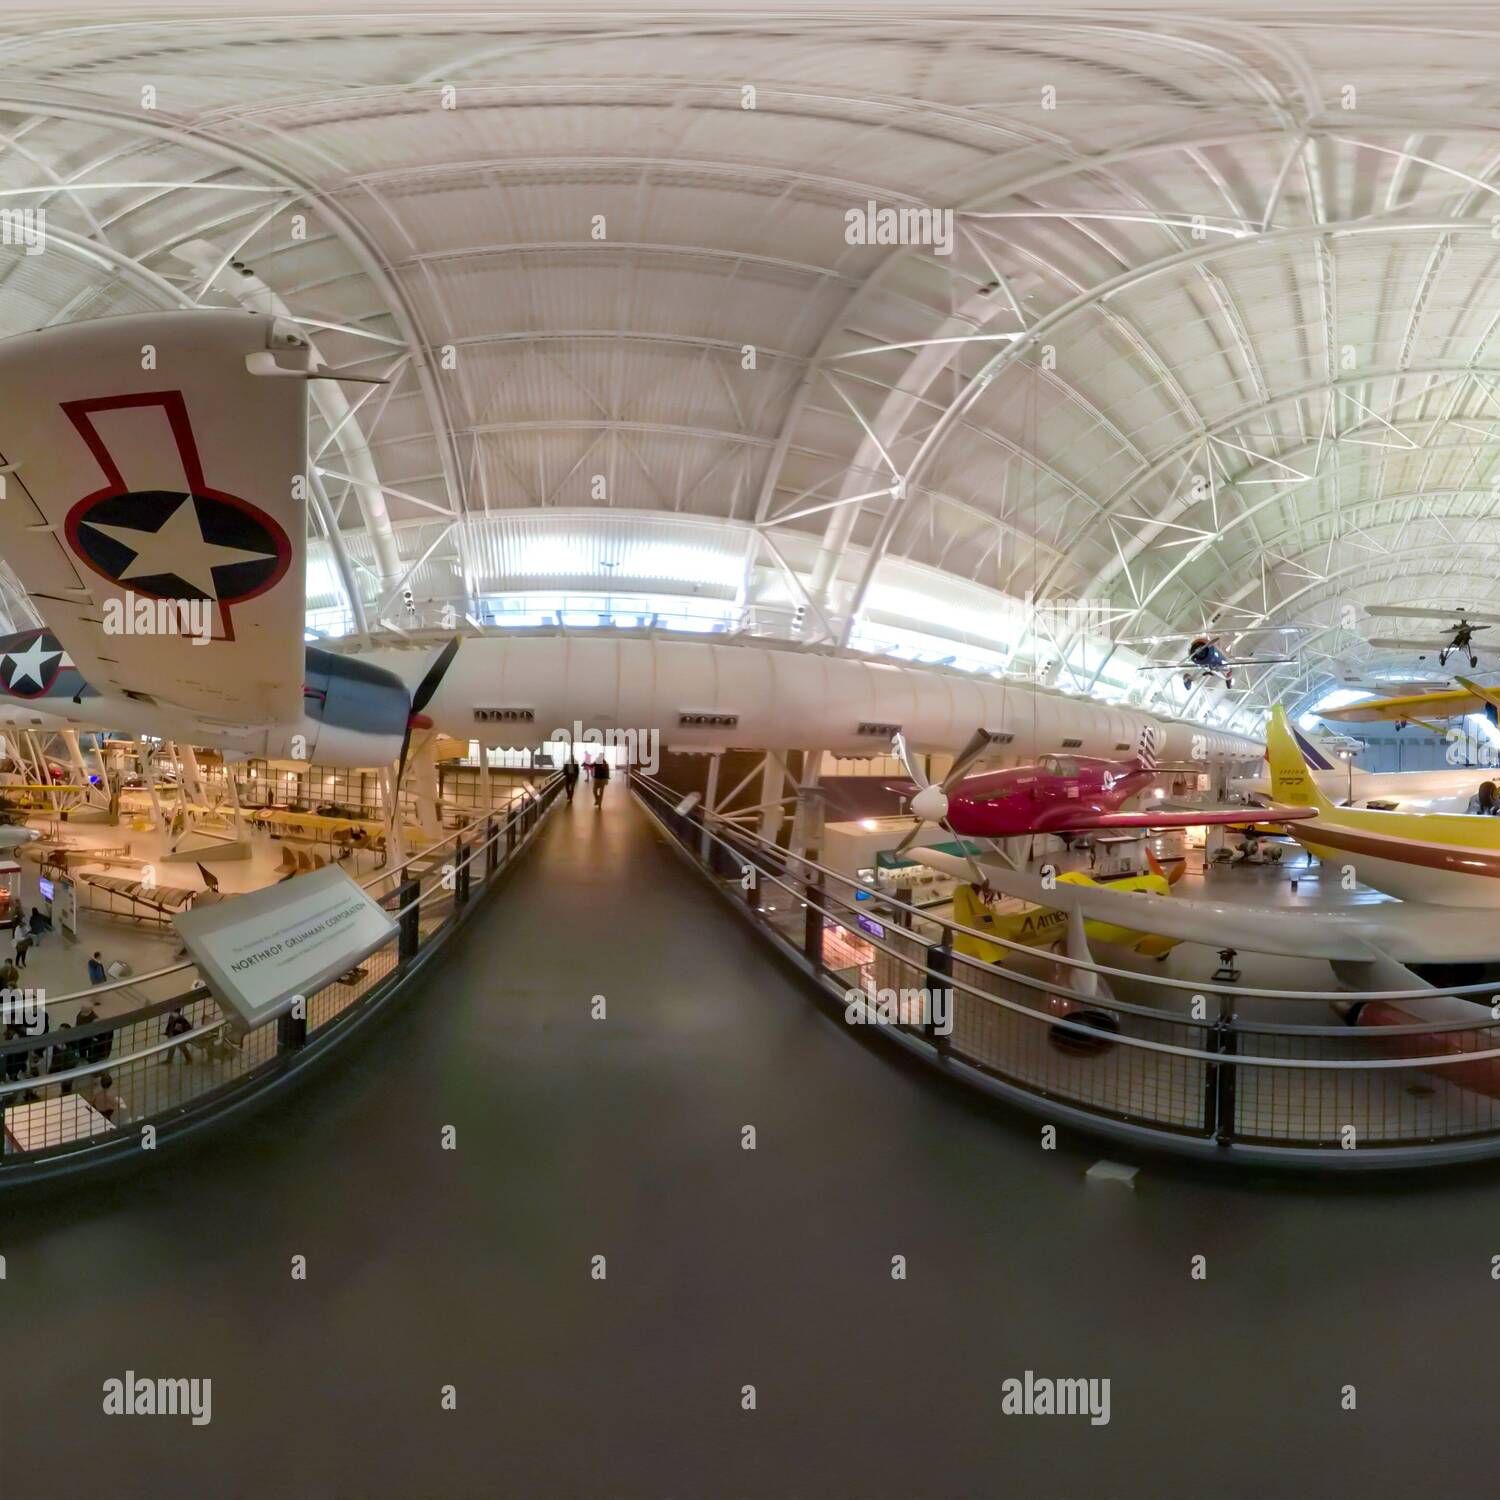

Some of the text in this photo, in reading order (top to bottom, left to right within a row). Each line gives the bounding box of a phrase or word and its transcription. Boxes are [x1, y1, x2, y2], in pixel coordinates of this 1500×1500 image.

[230, 944, 283, 972] NORTHROP
[284, 922, 325, 948] GRUMMAN
[325, 902, 366, 927] CORPORATION
